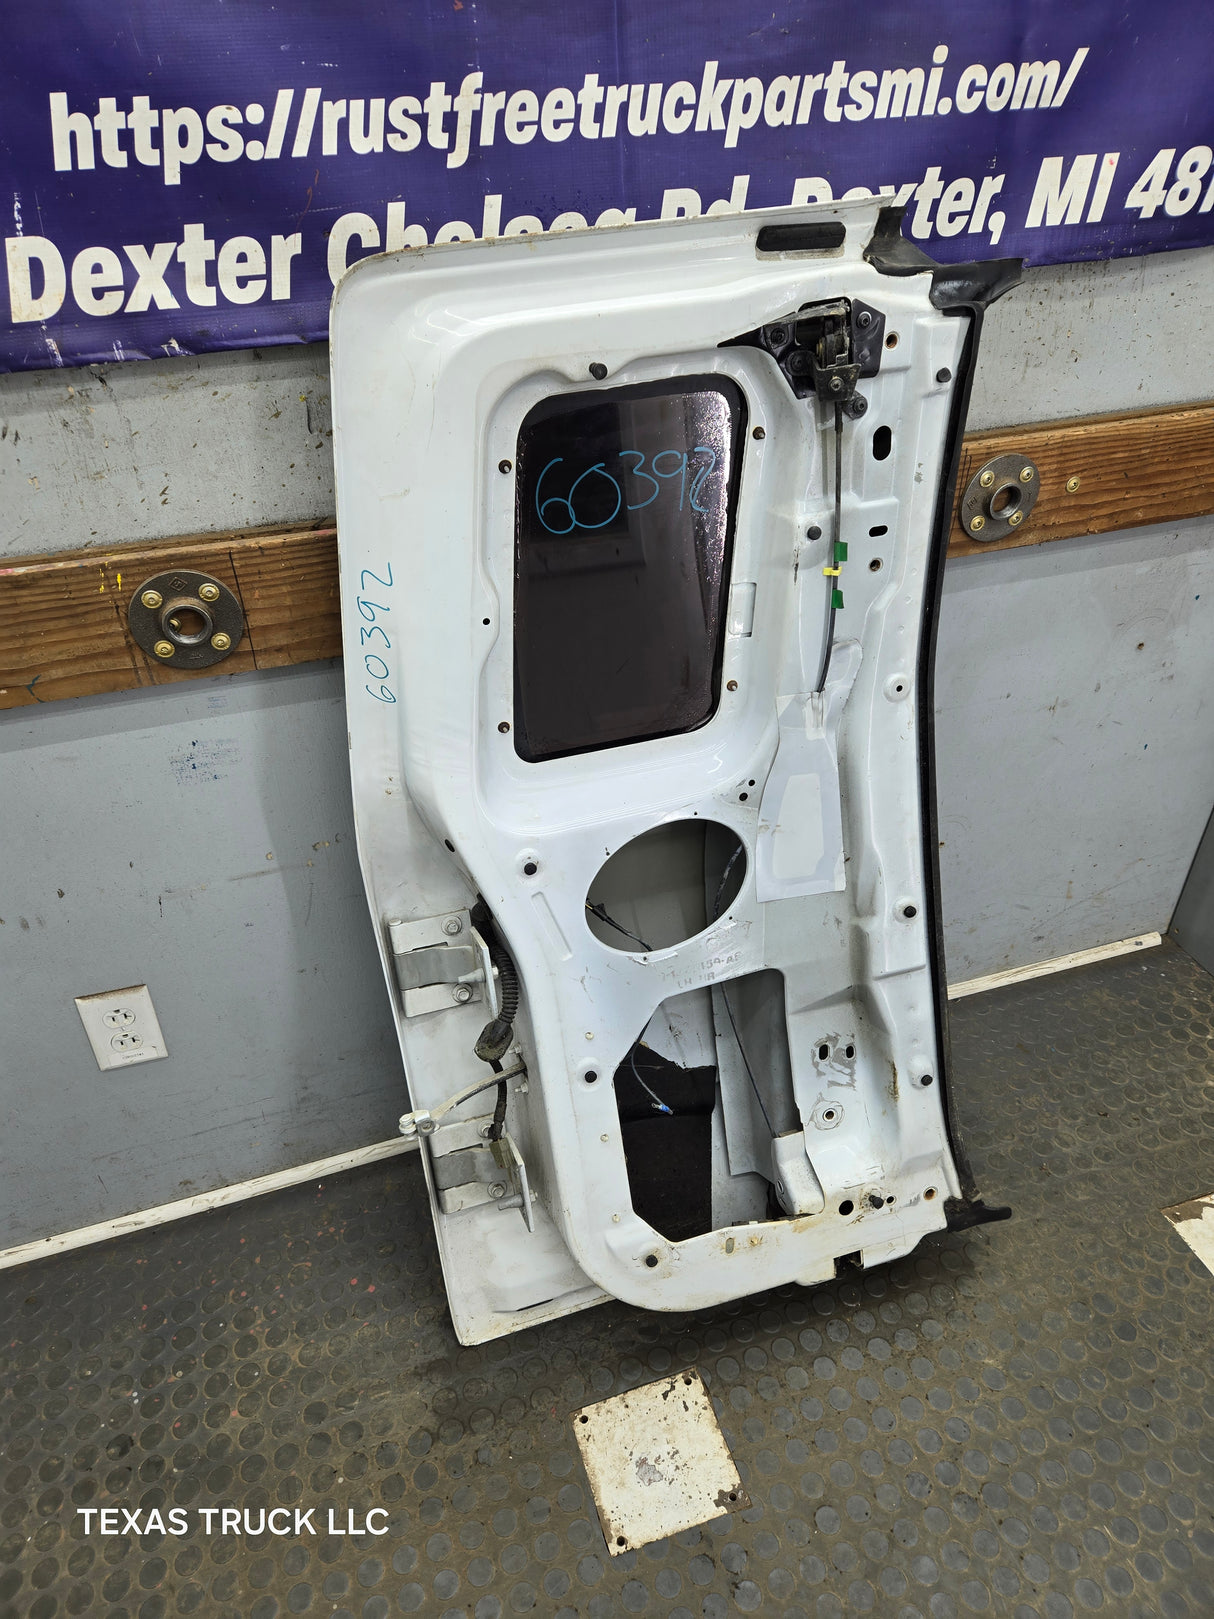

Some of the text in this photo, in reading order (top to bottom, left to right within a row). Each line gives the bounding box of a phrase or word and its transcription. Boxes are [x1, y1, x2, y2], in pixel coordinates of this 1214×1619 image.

[50, 45, 1090, 185] https://rustfreetruckpartsmi.com/
[4, 224, 302, 323] Dexter
[791, 165, 1006, 245] ter,
[1025, 152, 1120, 229] MI
[536, 446, 717, 534] 60392
[356, 562, 397, 703] 60392
